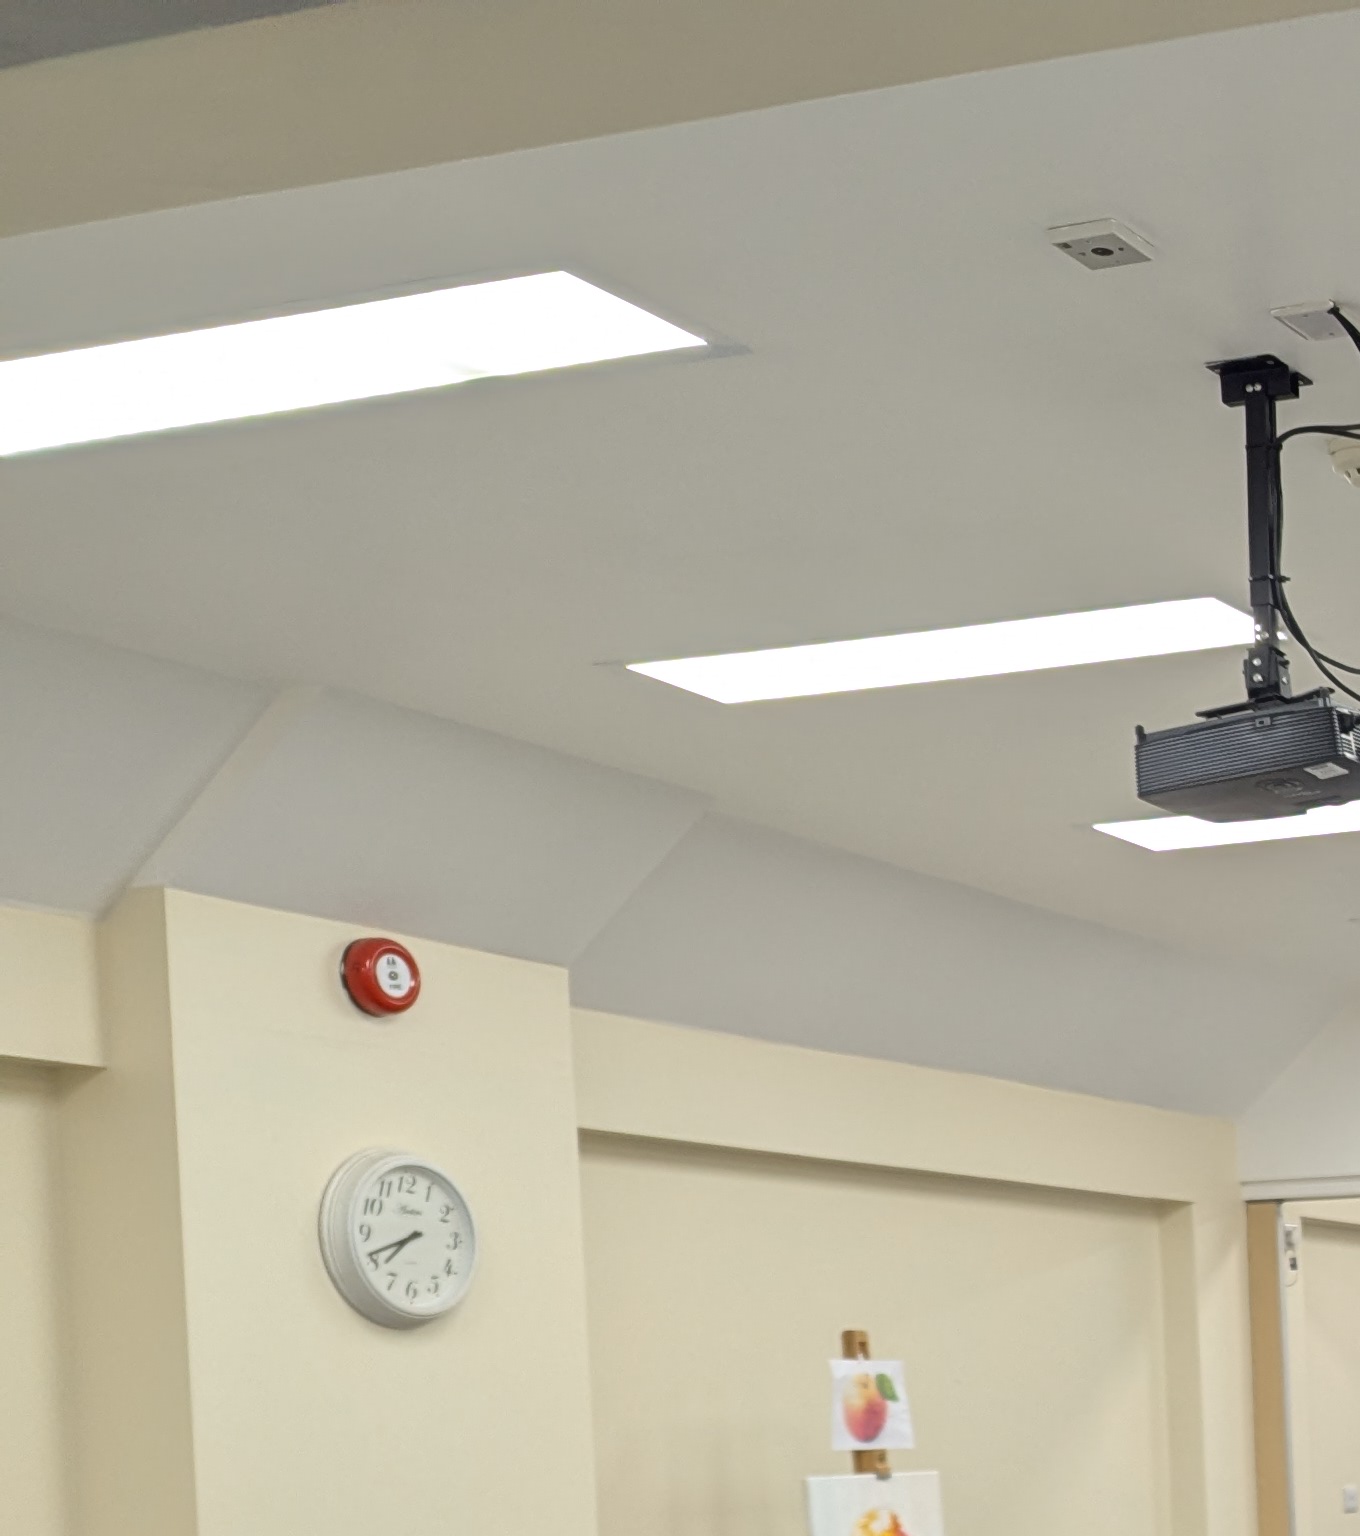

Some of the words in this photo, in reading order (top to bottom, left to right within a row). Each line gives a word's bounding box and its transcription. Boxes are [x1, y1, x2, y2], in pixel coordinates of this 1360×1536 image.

[379, 1180, 392, 1198] 11
[398, 1176, 417, 1194] 12
[425, 1185, 432, 1202] 1
[363, 1198, 383, 1216] 10
[439, 1204, 455, 1223] 2
[359, 1224, 371, 1242] 9
[446, 1231, 462, 1250] 3
[386, 1272, 398, 1291] 7
[405, 1281, 418, 1304] 6
